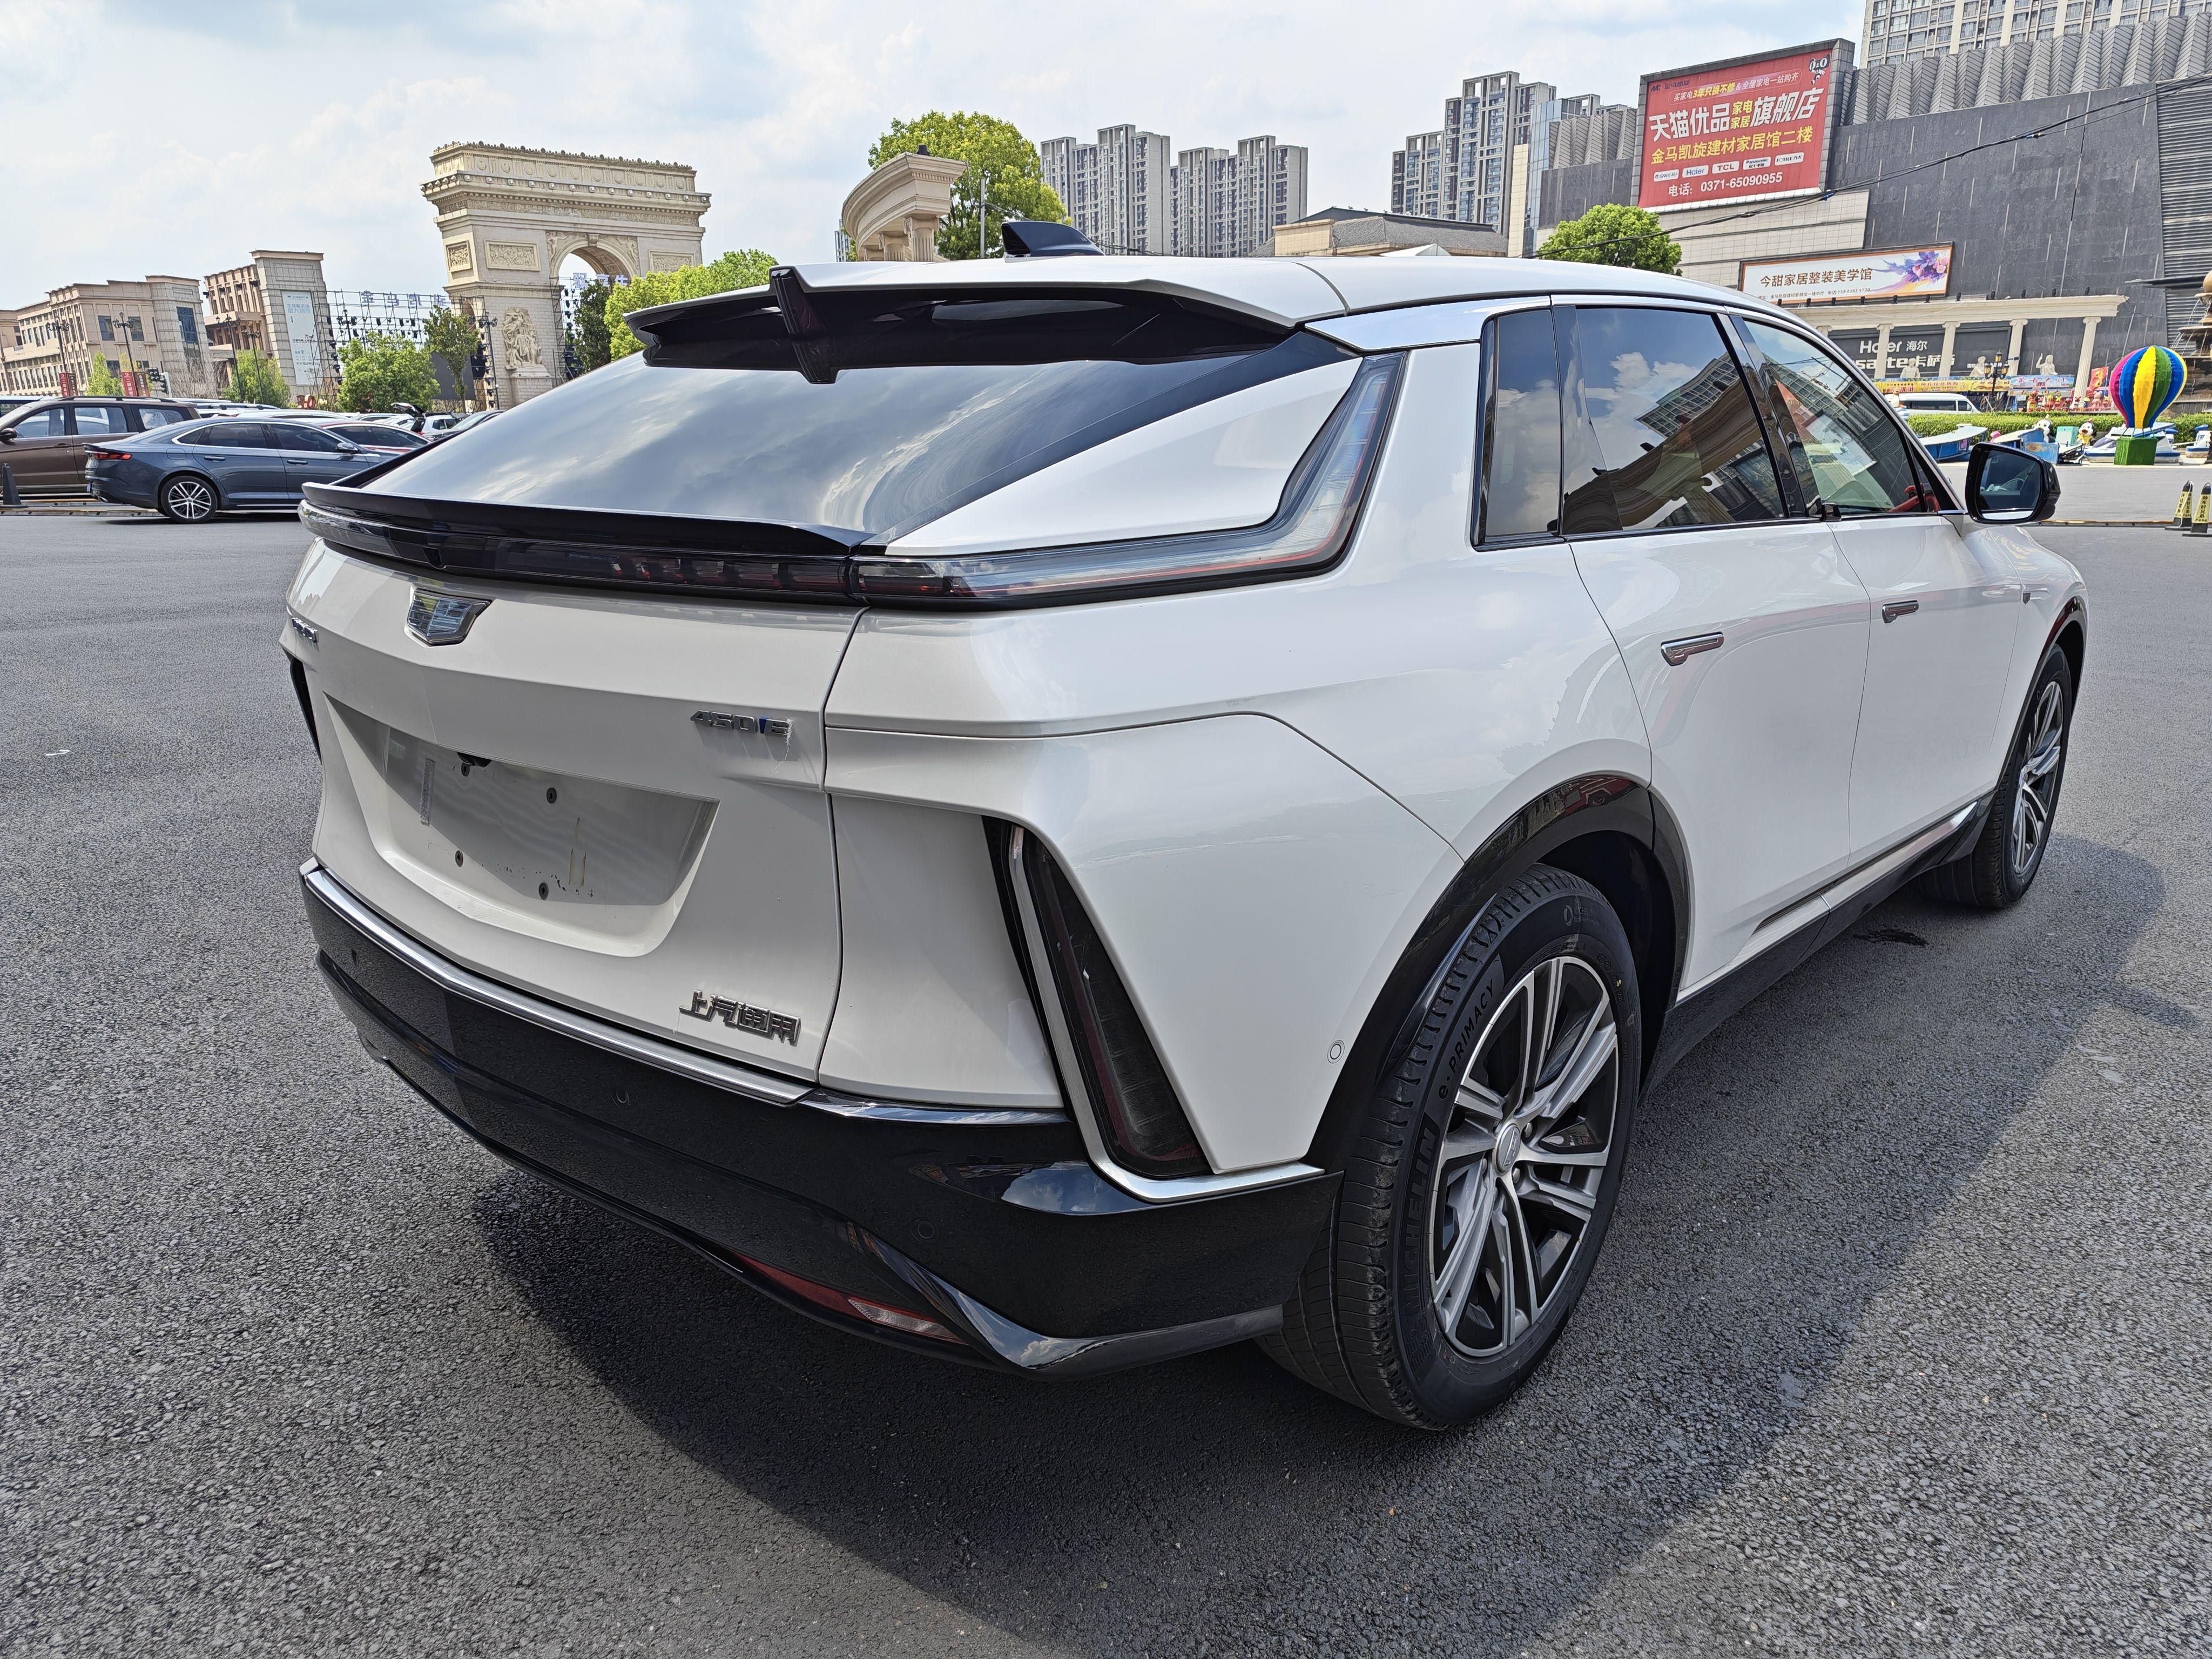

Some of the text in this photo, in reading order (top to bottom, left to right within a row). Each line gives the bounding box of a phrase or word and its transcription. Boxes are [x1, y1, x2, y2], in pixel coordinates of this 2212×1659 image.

[1732, 99, 1753, 115] 家电
[1750, 87, 1824, 127] 旗舰店
[1649, 103, 1730, 142] 天猫优品
[1730, 115, 1751, 130] 家居
[1651, 126, 1813, 165] 金马凯旋建材家居馆二楼
[1686, 168, 1705, 176] Haier
[1701, 172, 1783, 192] 0371-65090955
[1761, 268, 1873, 287] 今甜家居整装美学馆
[1906, 340, 1928, 352] 海尔
[679, 990, 802, 1047] 上汽通用
